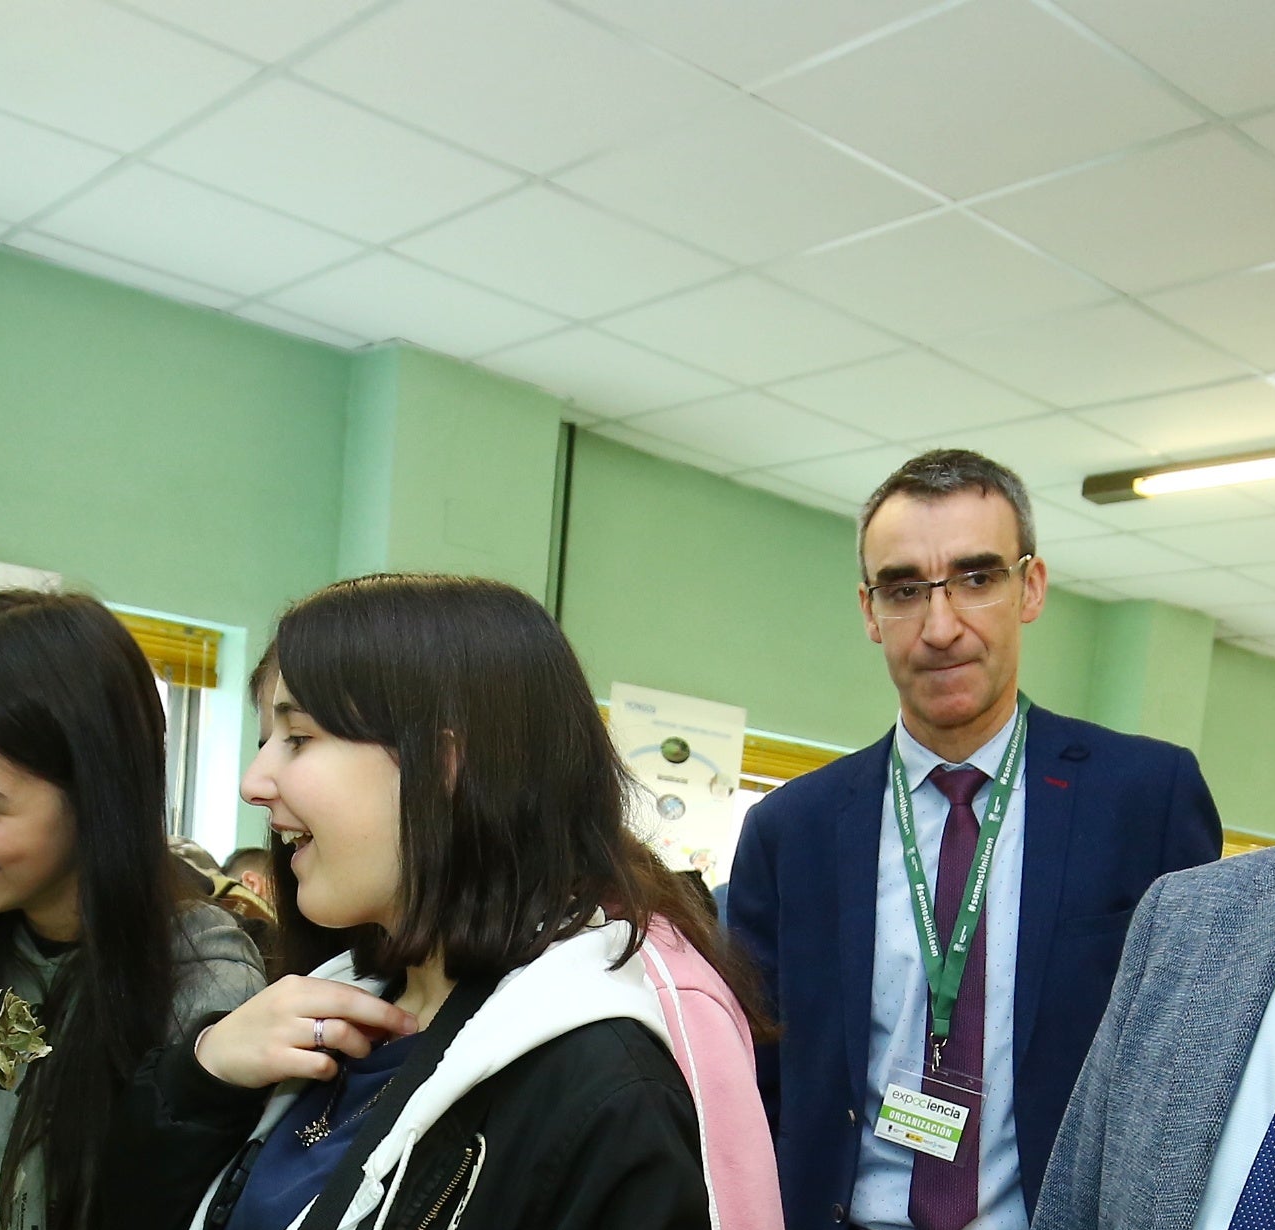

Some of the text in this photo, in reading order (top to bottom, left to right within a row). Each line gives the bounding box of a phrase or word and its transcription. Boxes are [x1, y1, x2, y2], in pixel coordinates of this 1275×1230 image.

[894, 768, 911, 836] #somosUnileon
[968, 837, 995, 913] #somosUnileon
[915, 883, 938, 958] #somosUnileon
[888, 1110, 953, 1138] ORGANIZACIÓN
[892, 1090, 961, 1120] expociencia
